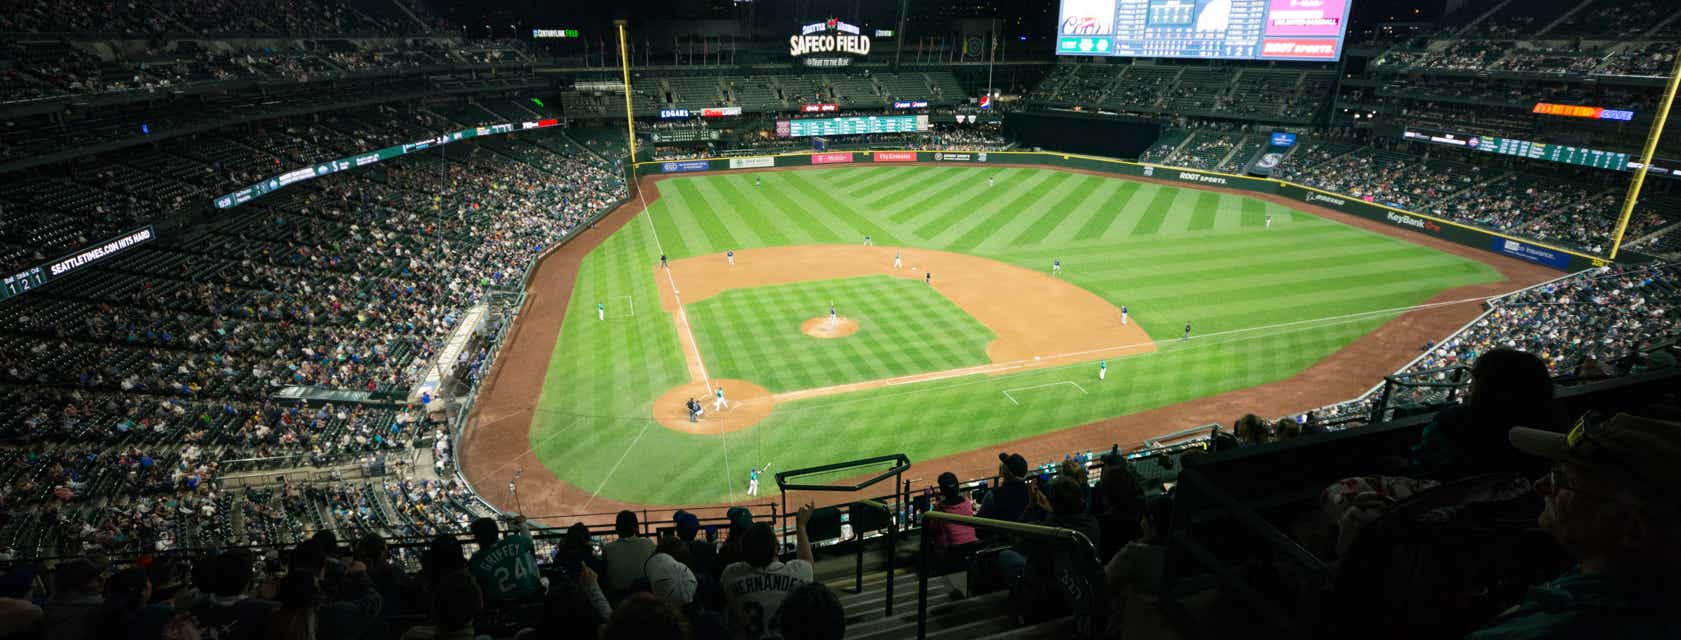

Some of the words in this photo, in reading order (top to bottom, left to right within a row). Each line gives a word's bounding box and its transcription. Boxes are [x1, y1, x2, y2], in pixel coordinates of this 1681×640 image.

[790, 35, 835, 56] SAFECO
[836, 35, 871, 55] FIELD
[1179, 172, 1200, 181] ROOT
[1387, 211, 1425, 228] KeyBank
[51, 240, 118, 276] SEATTLETIMES.COM
[118, 236, 133, 249] HITS
[133, 230, 150, 243] HARD
[9, 284, 17, 295] 1
[22, 279, 30, 290] 2
[35, 274, 41, 284] 1
[480, 543, 520, 571] GRIFFEY
[494, 557, 528, 593] 24
